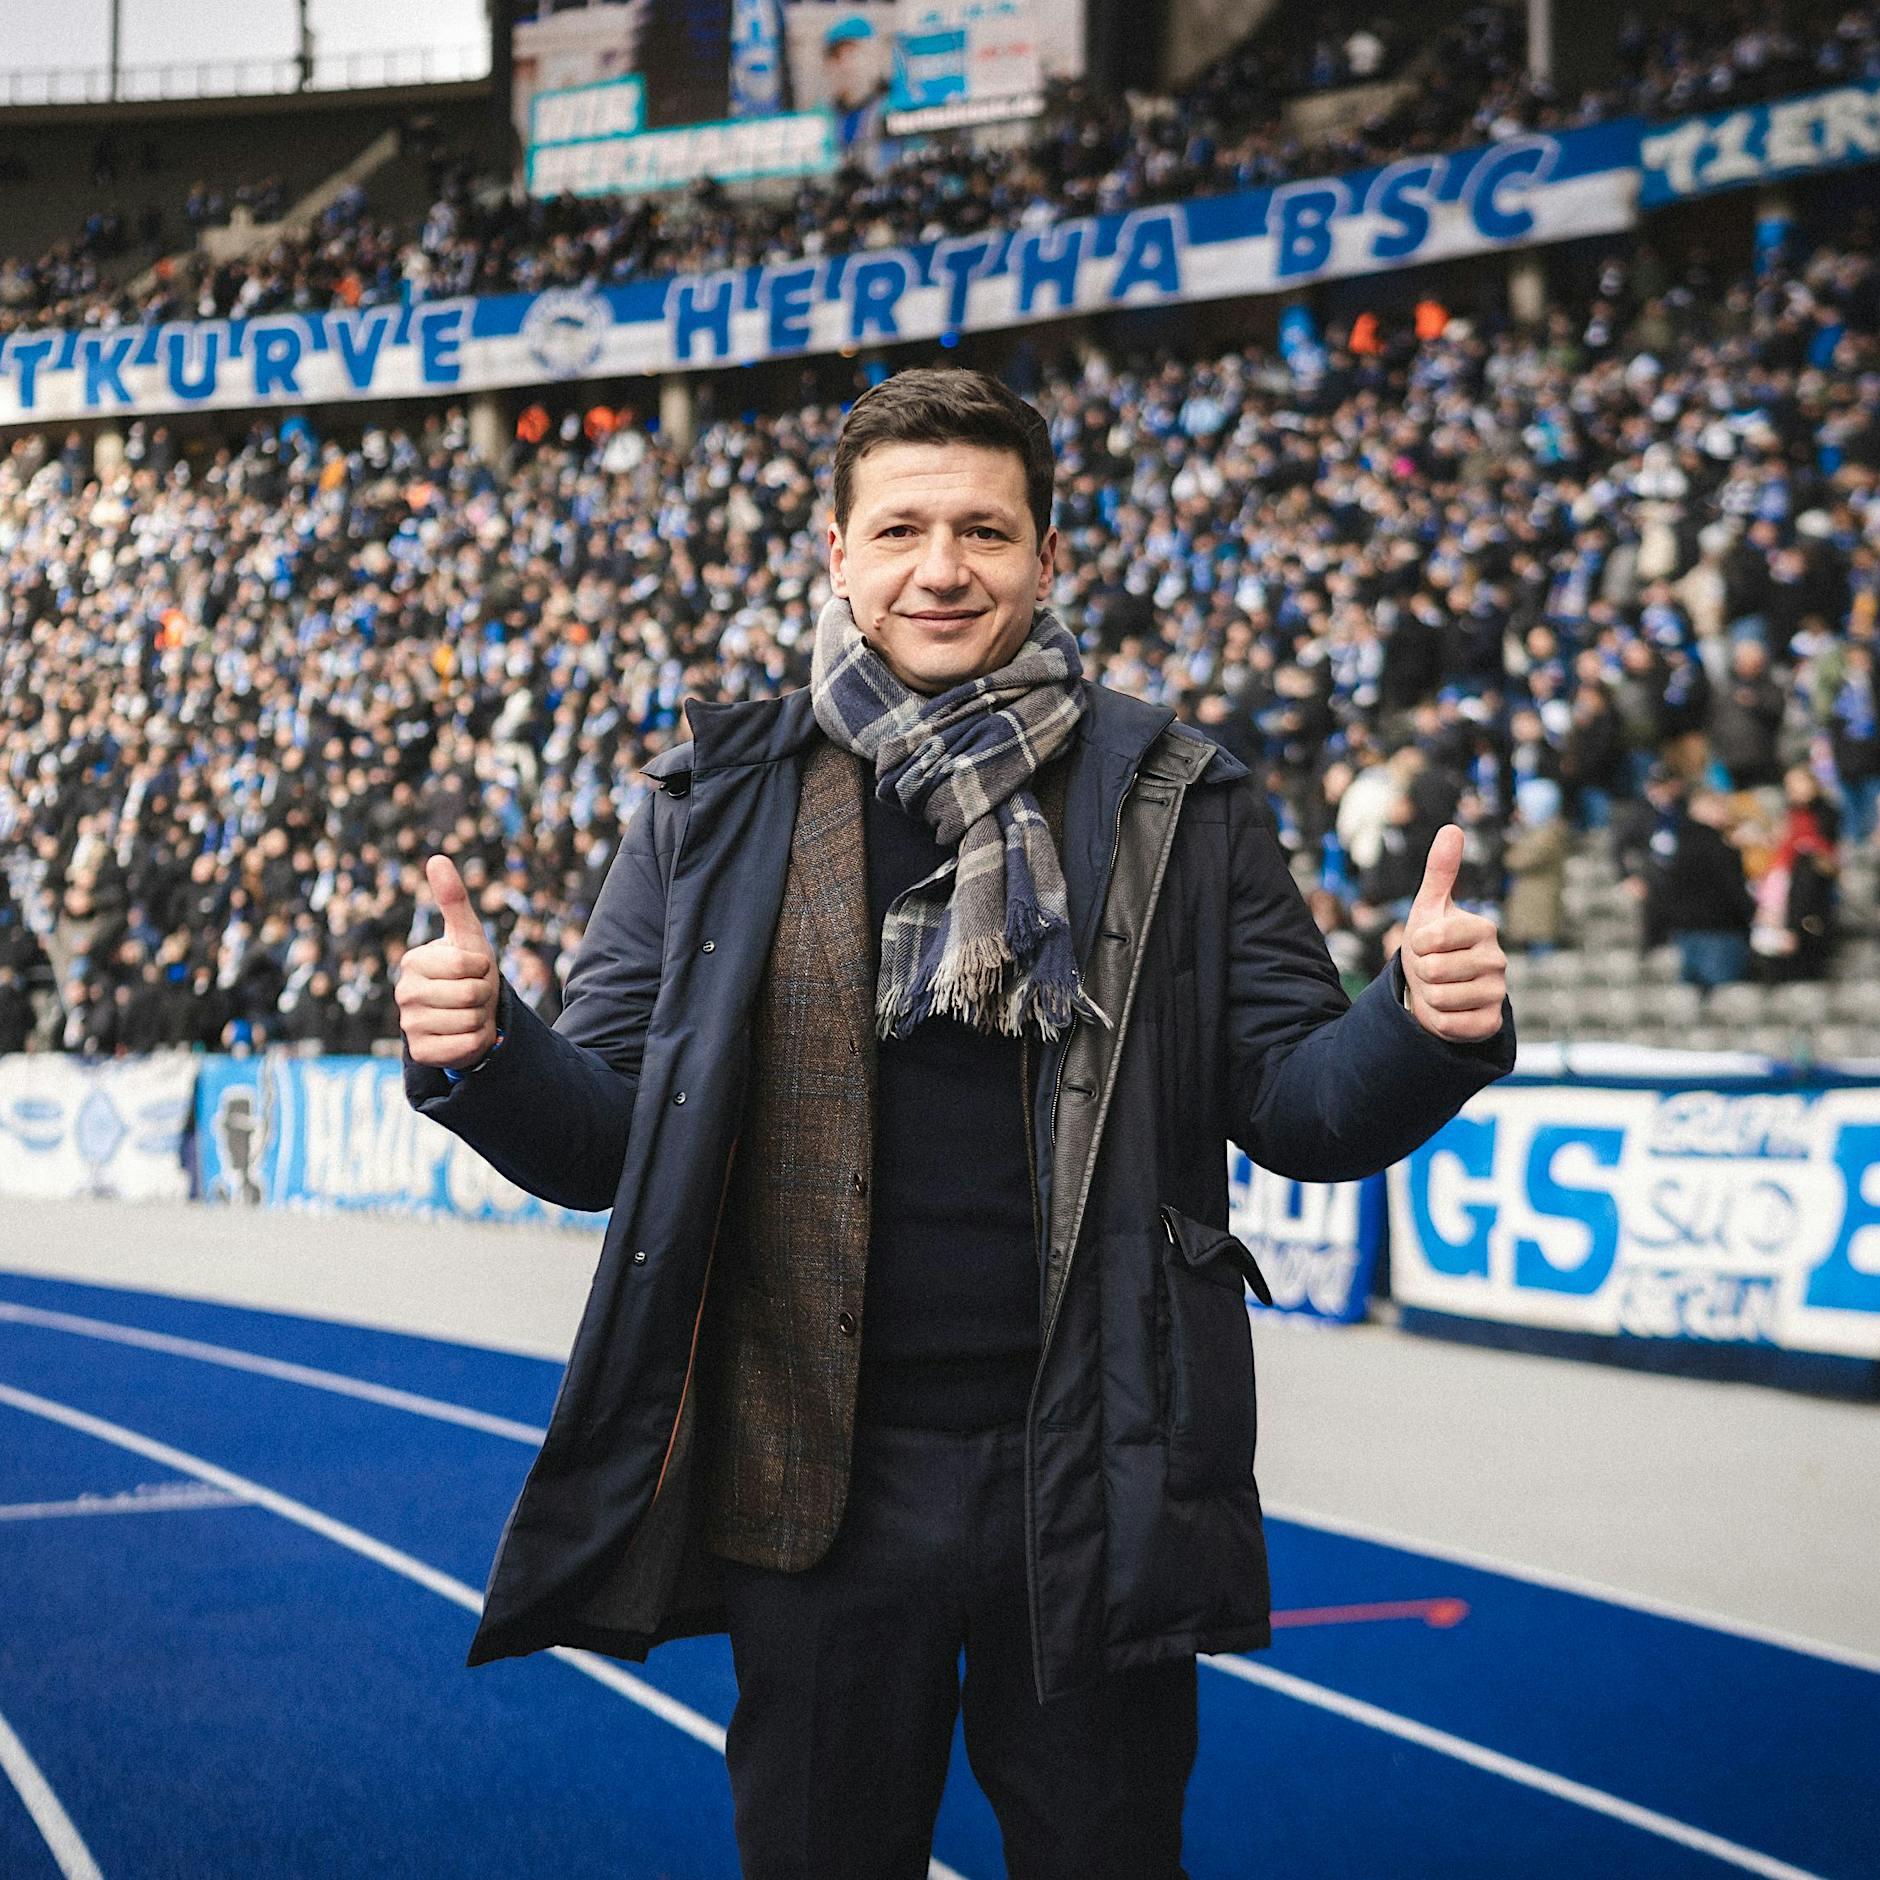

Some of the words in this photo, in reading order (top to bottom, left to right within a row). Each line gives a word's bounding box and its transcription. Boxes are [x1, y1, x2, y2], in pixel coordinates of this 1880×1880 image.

[1641, 86, 1880, 194] TIER
[668, 208, 1184, 361] HERTHA
[1270, 138, 1556, 278] BSC
